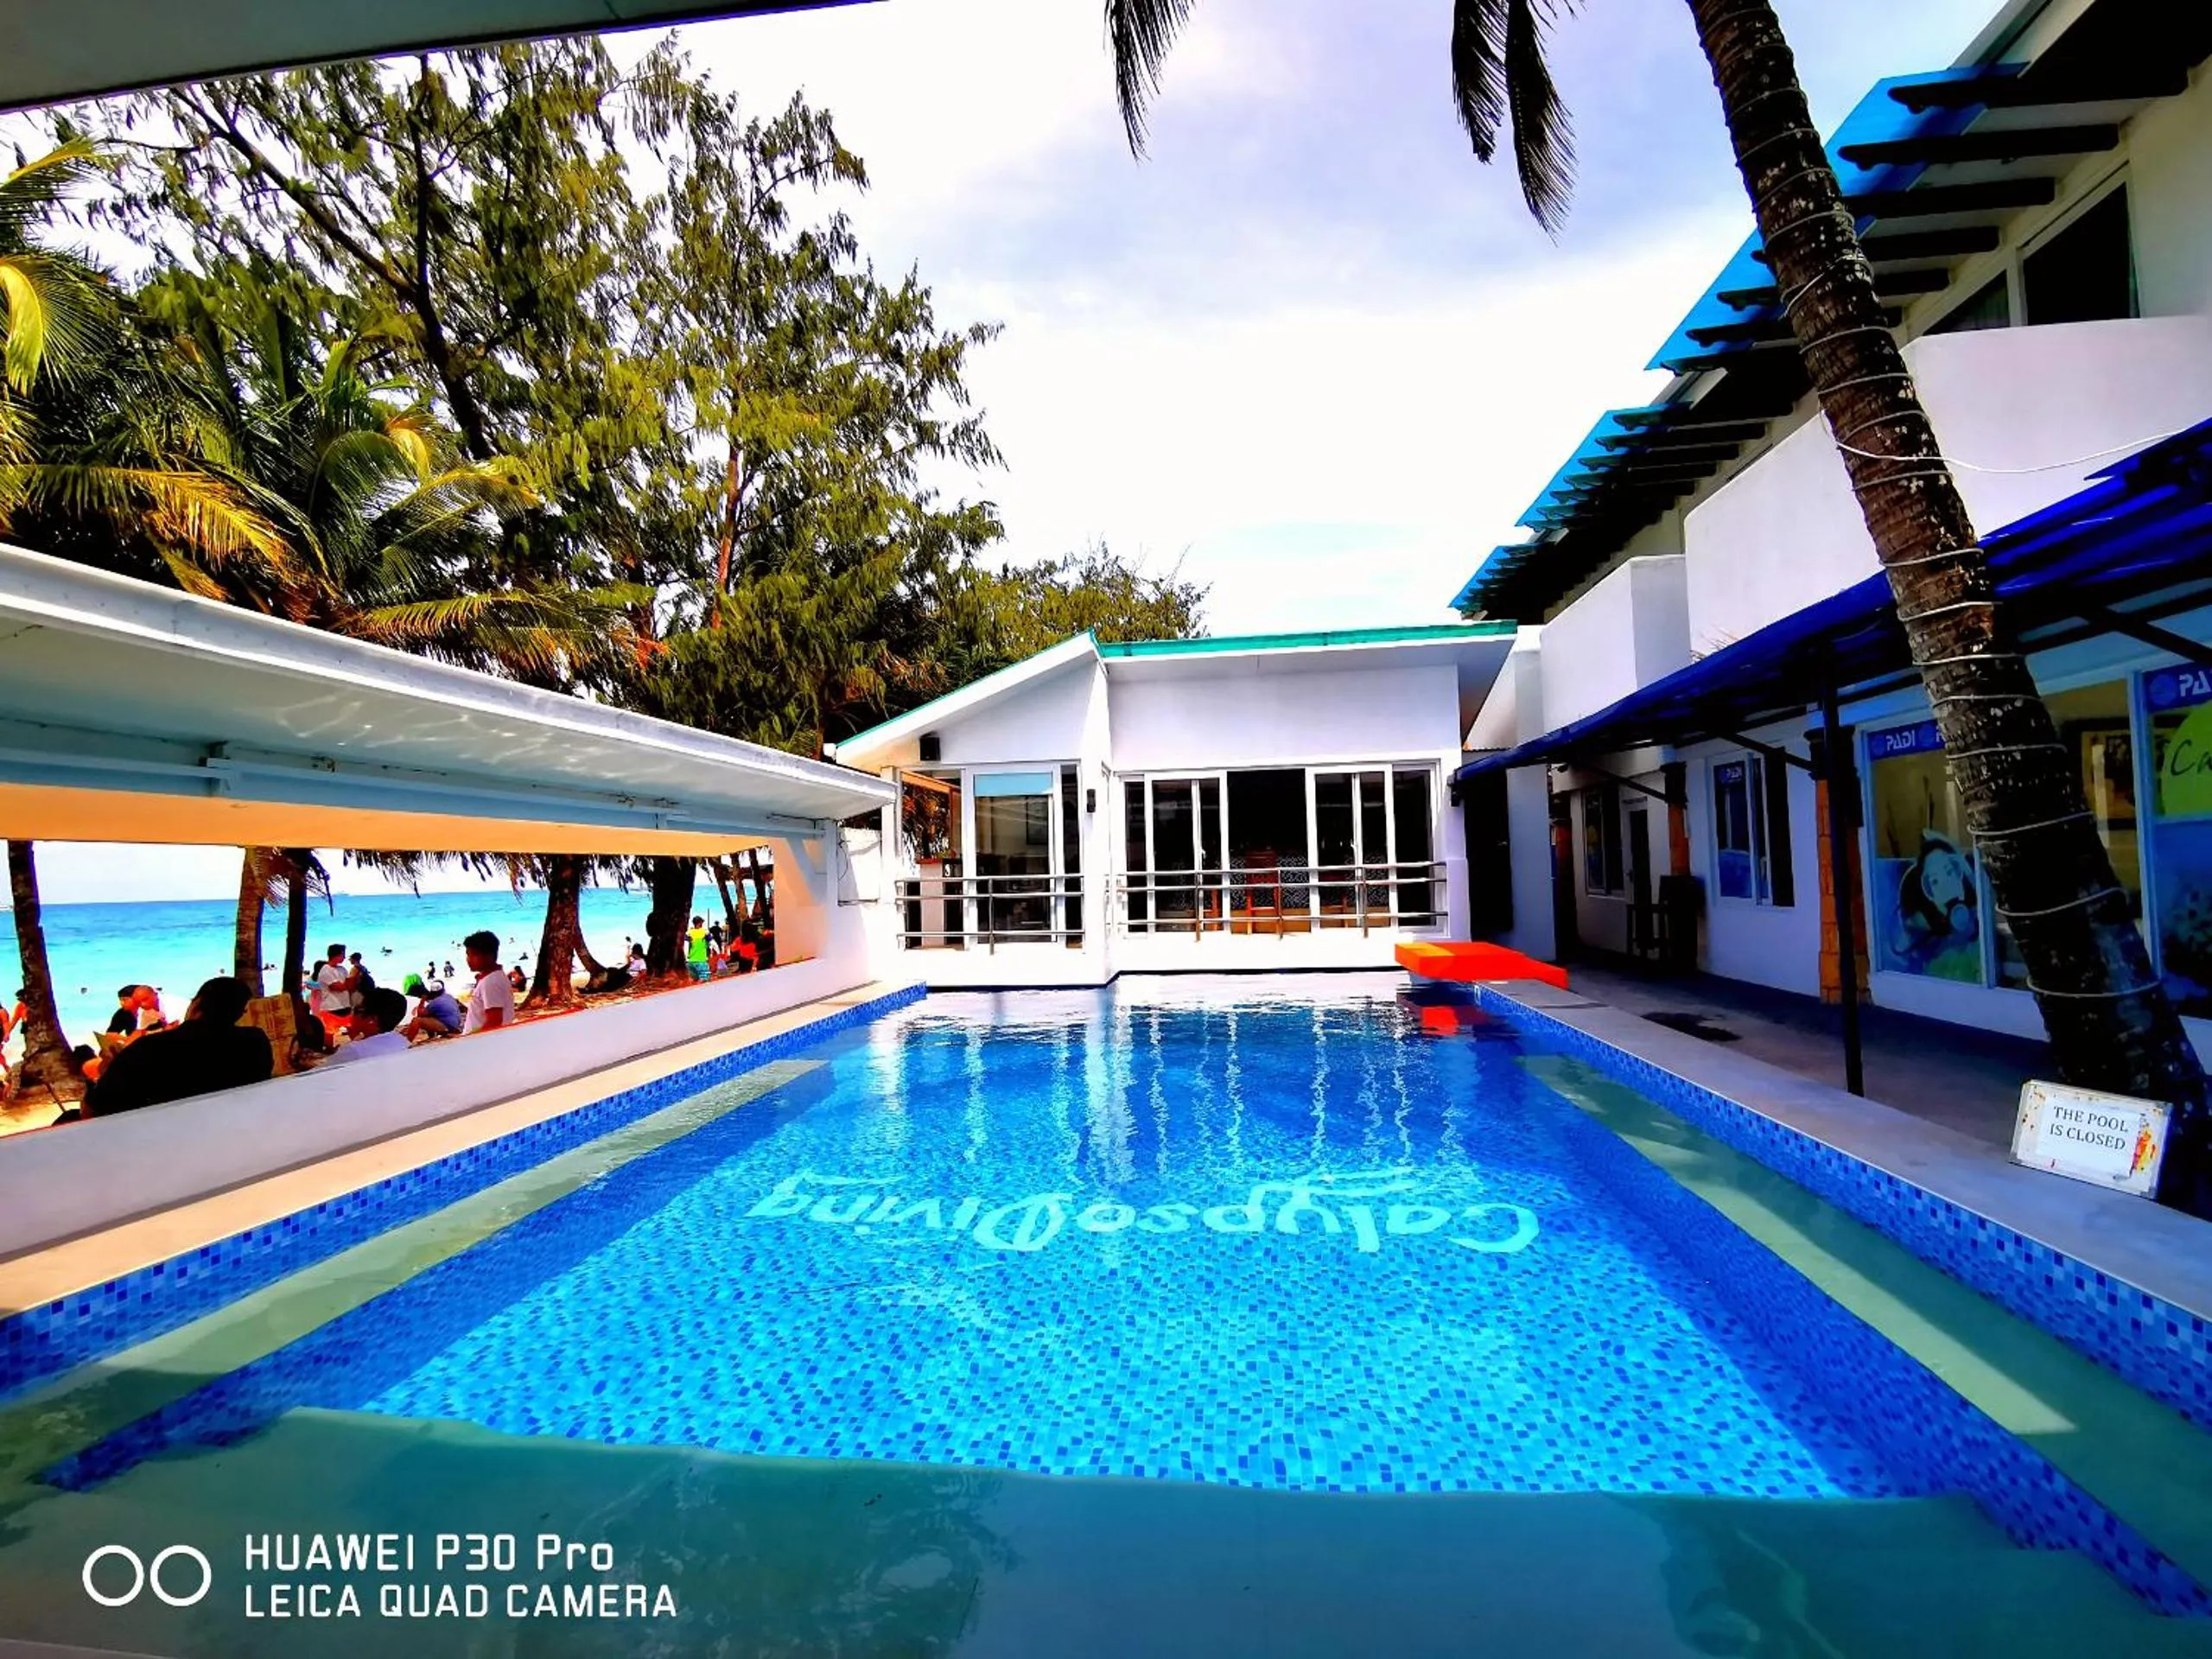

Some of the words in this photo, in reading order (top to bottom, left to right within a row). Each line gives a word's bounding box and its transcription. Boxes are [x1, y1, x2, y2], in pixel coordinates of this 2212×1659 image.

[2178, 670, 2212, 697] PA
[1885, 729, 1916, 752] PADI
[2053, 1106, 2084, 1123] THE
[2087, 1112, 2129, 1133] POOL
[2049, 1122, 2064, 1137] IS
[2066, 1127, 2126, 1150] CLOSED
